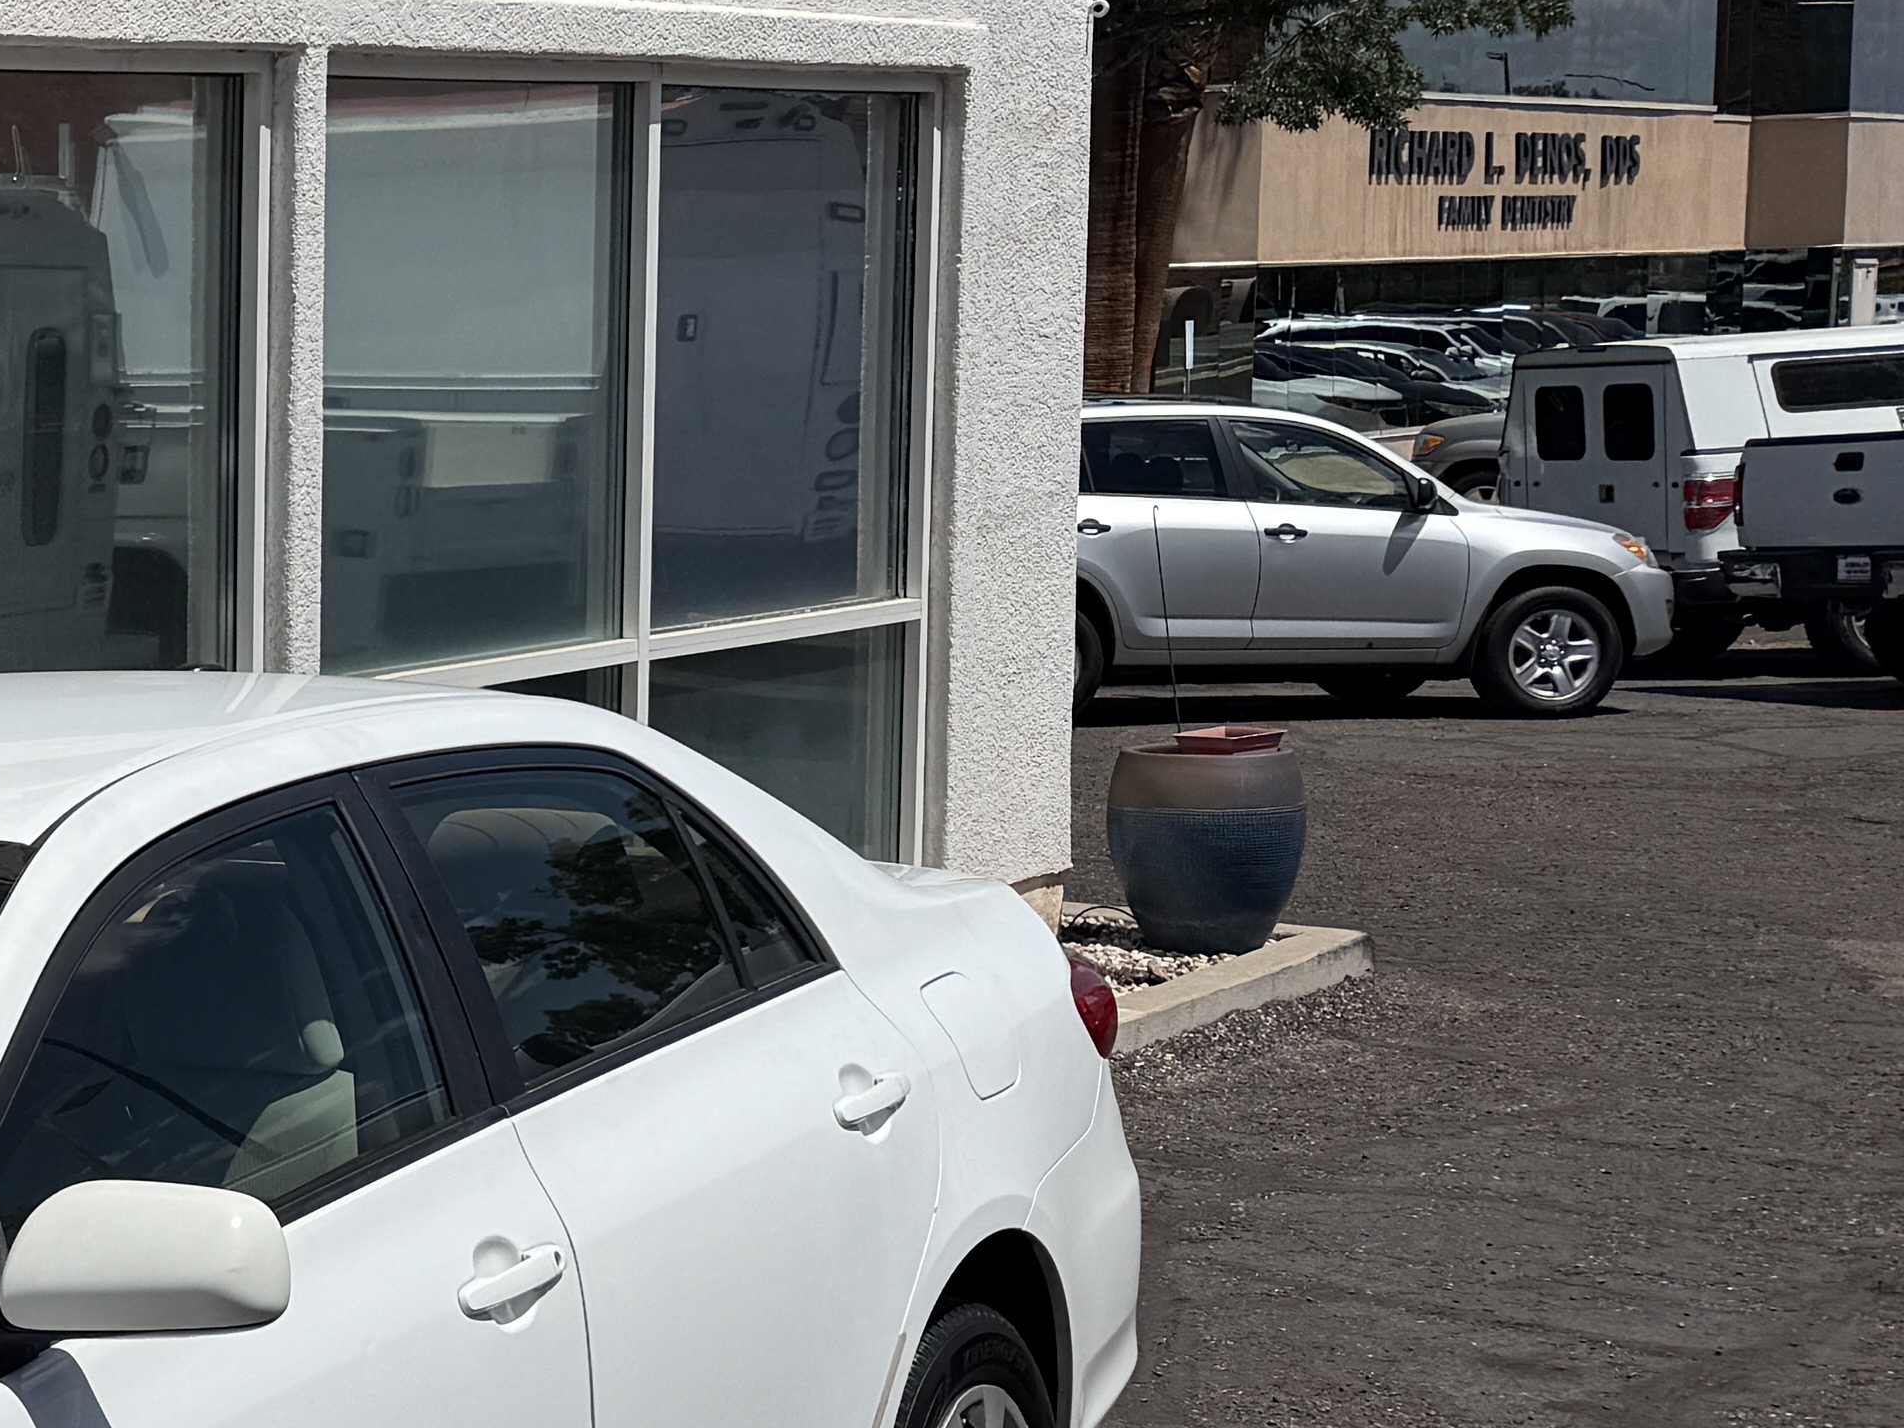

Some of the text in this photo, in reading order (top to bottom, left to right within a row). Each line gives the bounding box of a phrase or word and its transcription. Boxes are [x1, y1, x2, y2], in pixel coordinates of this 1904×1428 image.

[1368, 130, 1475, 184] RICHARD
[1599, 133, 1642, 187] DDS
[1437, 194, 1578, 230] FAMILY DENTISTRY
